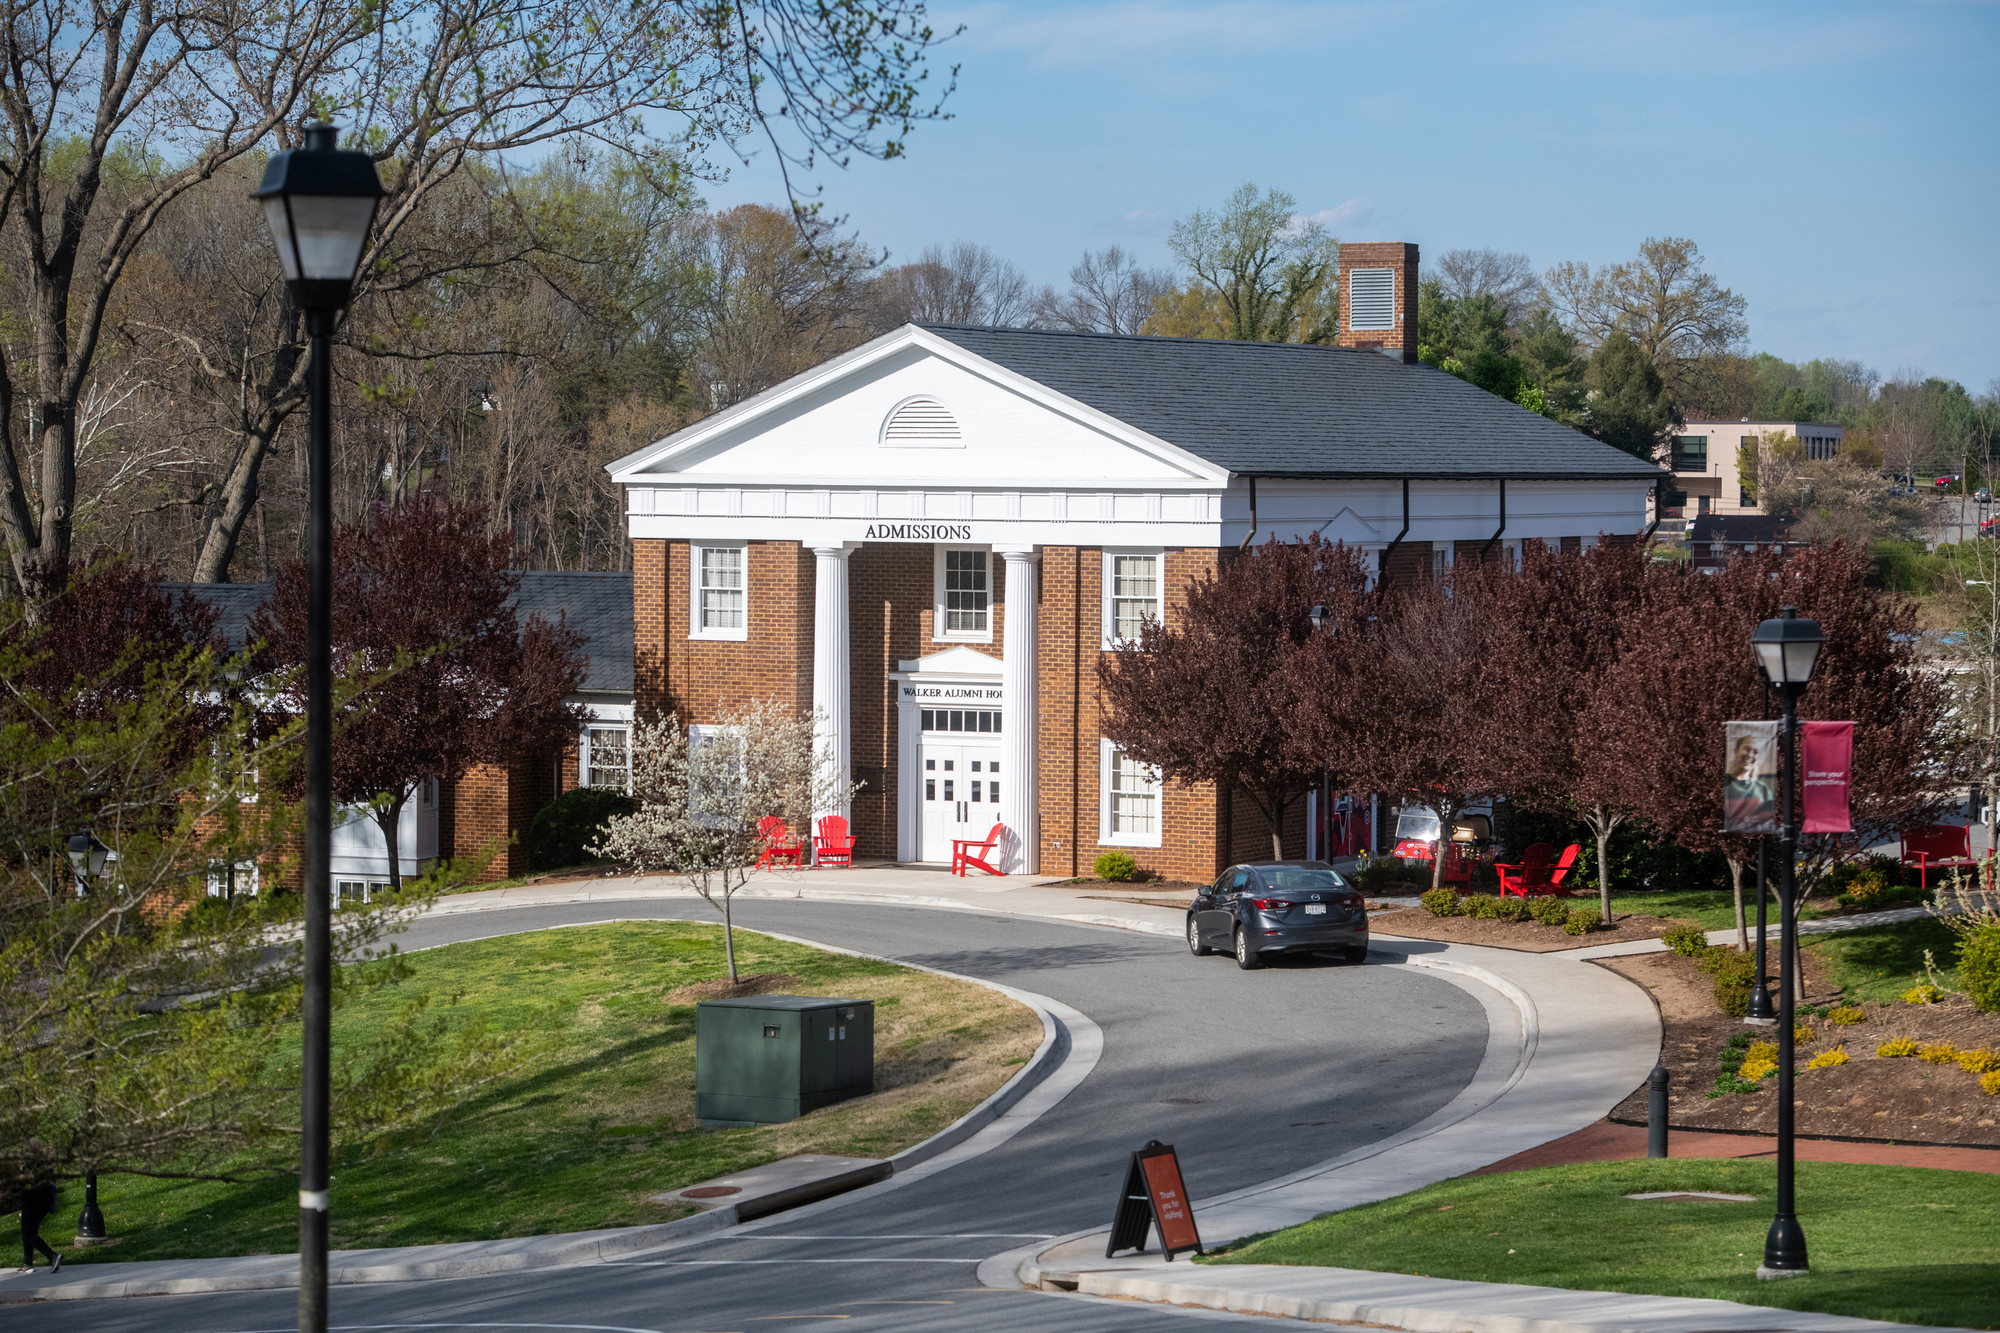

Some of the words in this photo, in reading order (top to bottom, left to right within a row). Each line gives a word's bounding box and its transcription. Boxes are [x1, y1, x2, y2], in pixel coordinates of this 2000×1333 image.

[865, 524, 971, 540] ADMISSIONS
[903, 688, 941, 698] WALKER
[945, 689, 983, 698] ALUMNI
[1159, 1189, 1176, 1199] Thank
[1161, 1203, 1172, 1212] you
[1171, 1200, 1180, 1208] for
